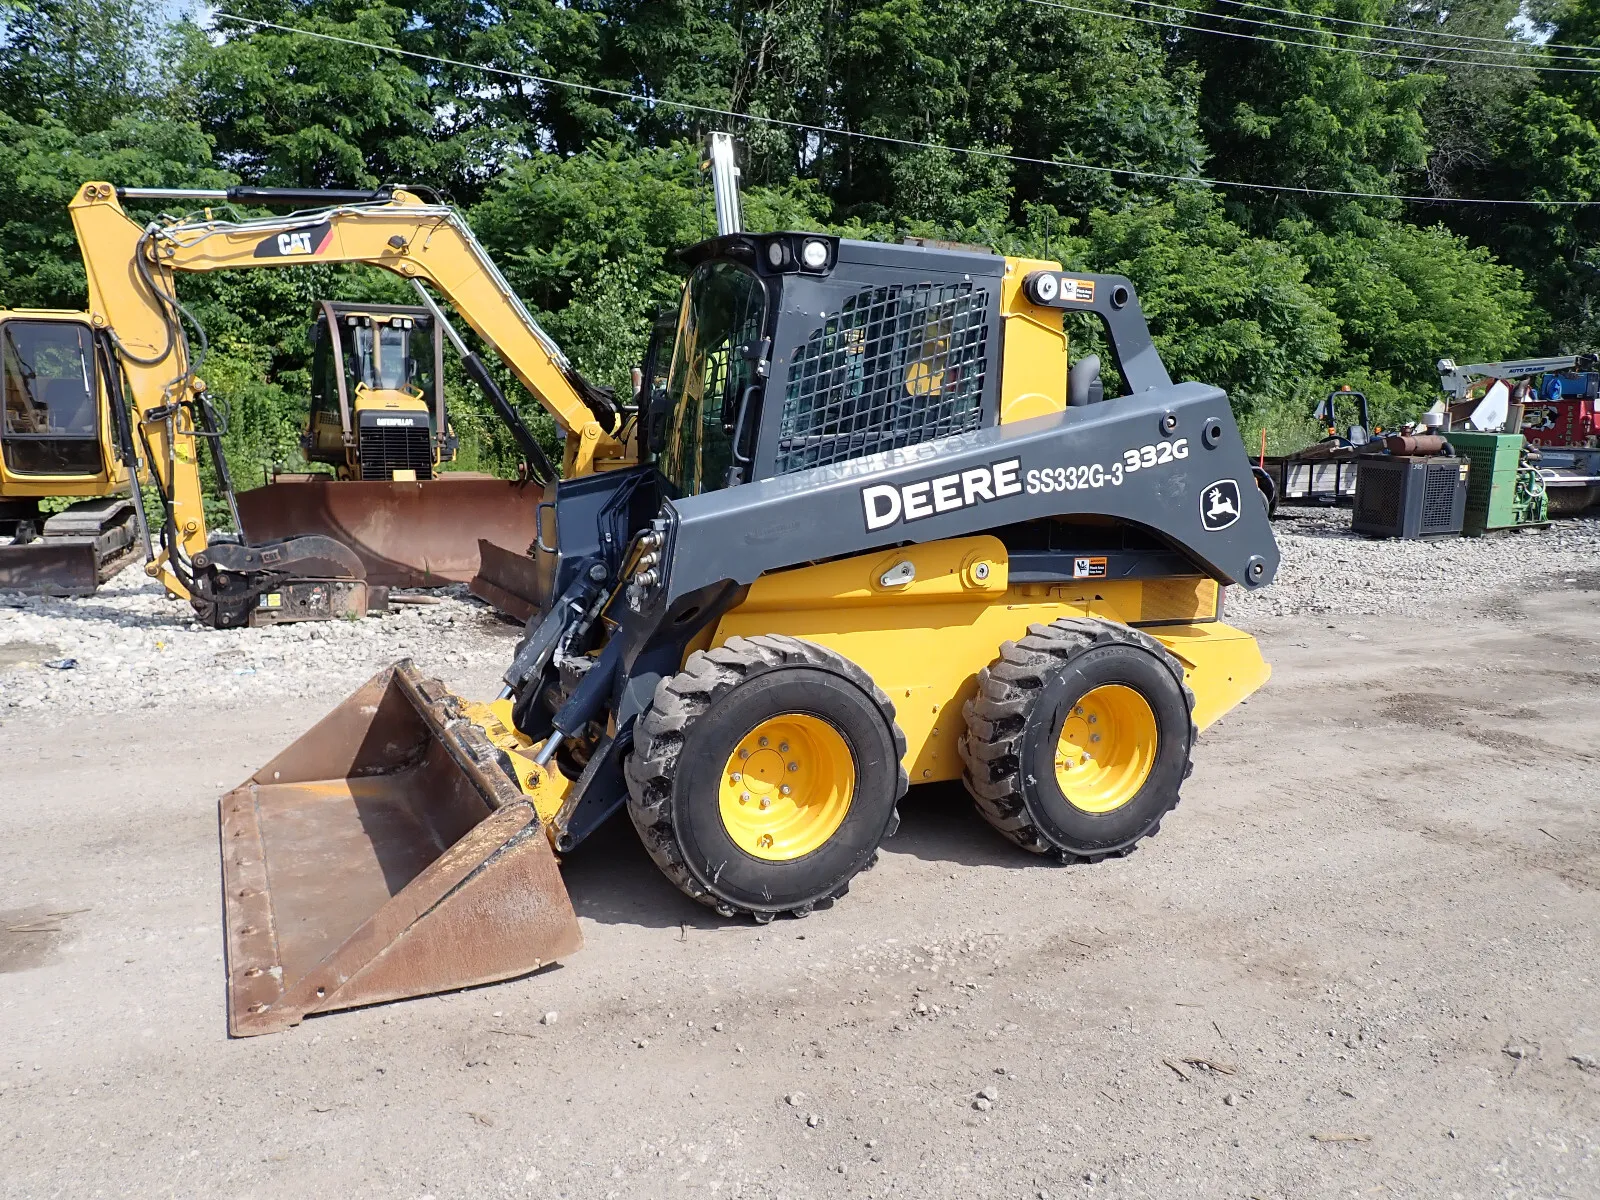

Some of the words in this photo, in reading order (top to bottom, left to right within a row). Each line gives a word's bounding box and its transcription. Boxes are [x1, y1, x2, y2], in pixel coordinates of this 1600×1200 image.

[277, 232, 312, 255] CAT
[861, 458, 1023, 531] DEERE
[1026, 462, 1124, 494] SS332G-3
[1123, 438, 1189, 473] 332G
